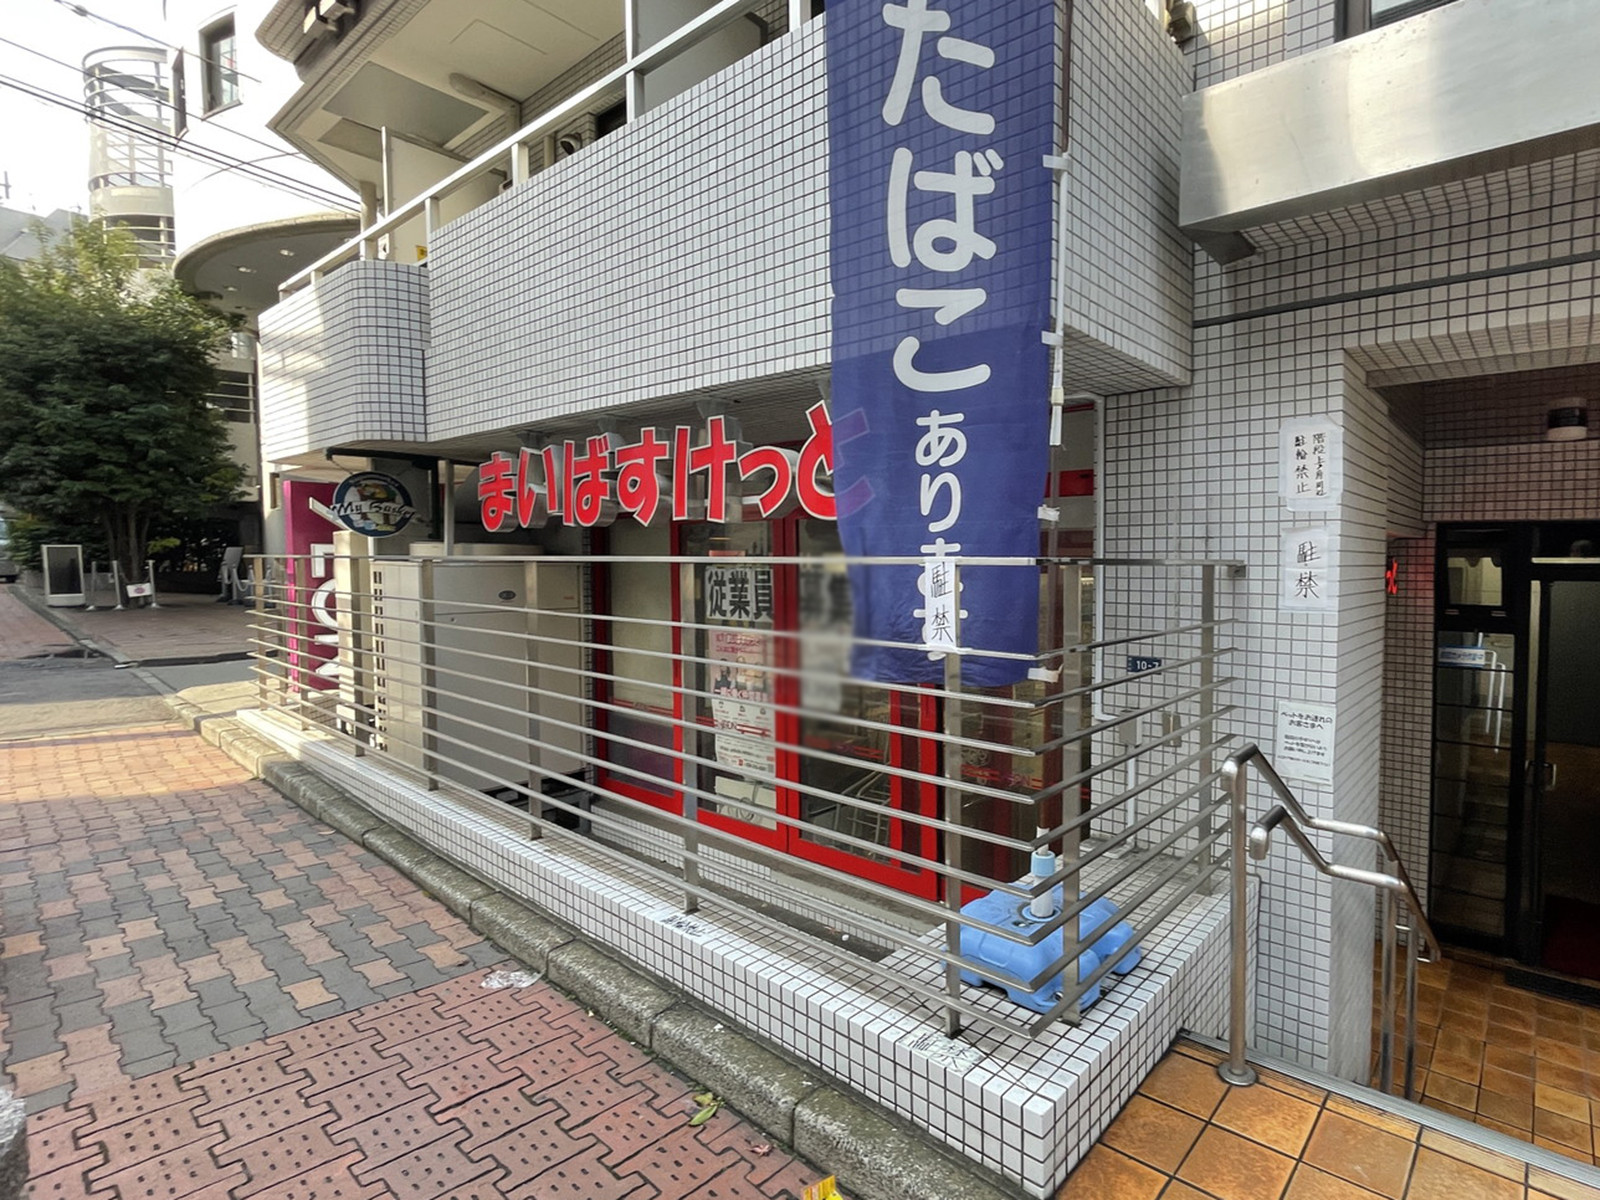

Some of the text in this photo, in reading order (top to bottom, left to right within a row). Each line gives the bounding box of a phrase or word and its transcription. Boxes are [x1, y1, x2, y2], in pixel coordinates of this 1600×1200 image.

[479, 400, 876, 533] まいばすけっと
[708, 569, 773, 620] 従業員
[930, 561, 954, 643] 駐禁
[1294, 540, 1321, 600] 駐禁
